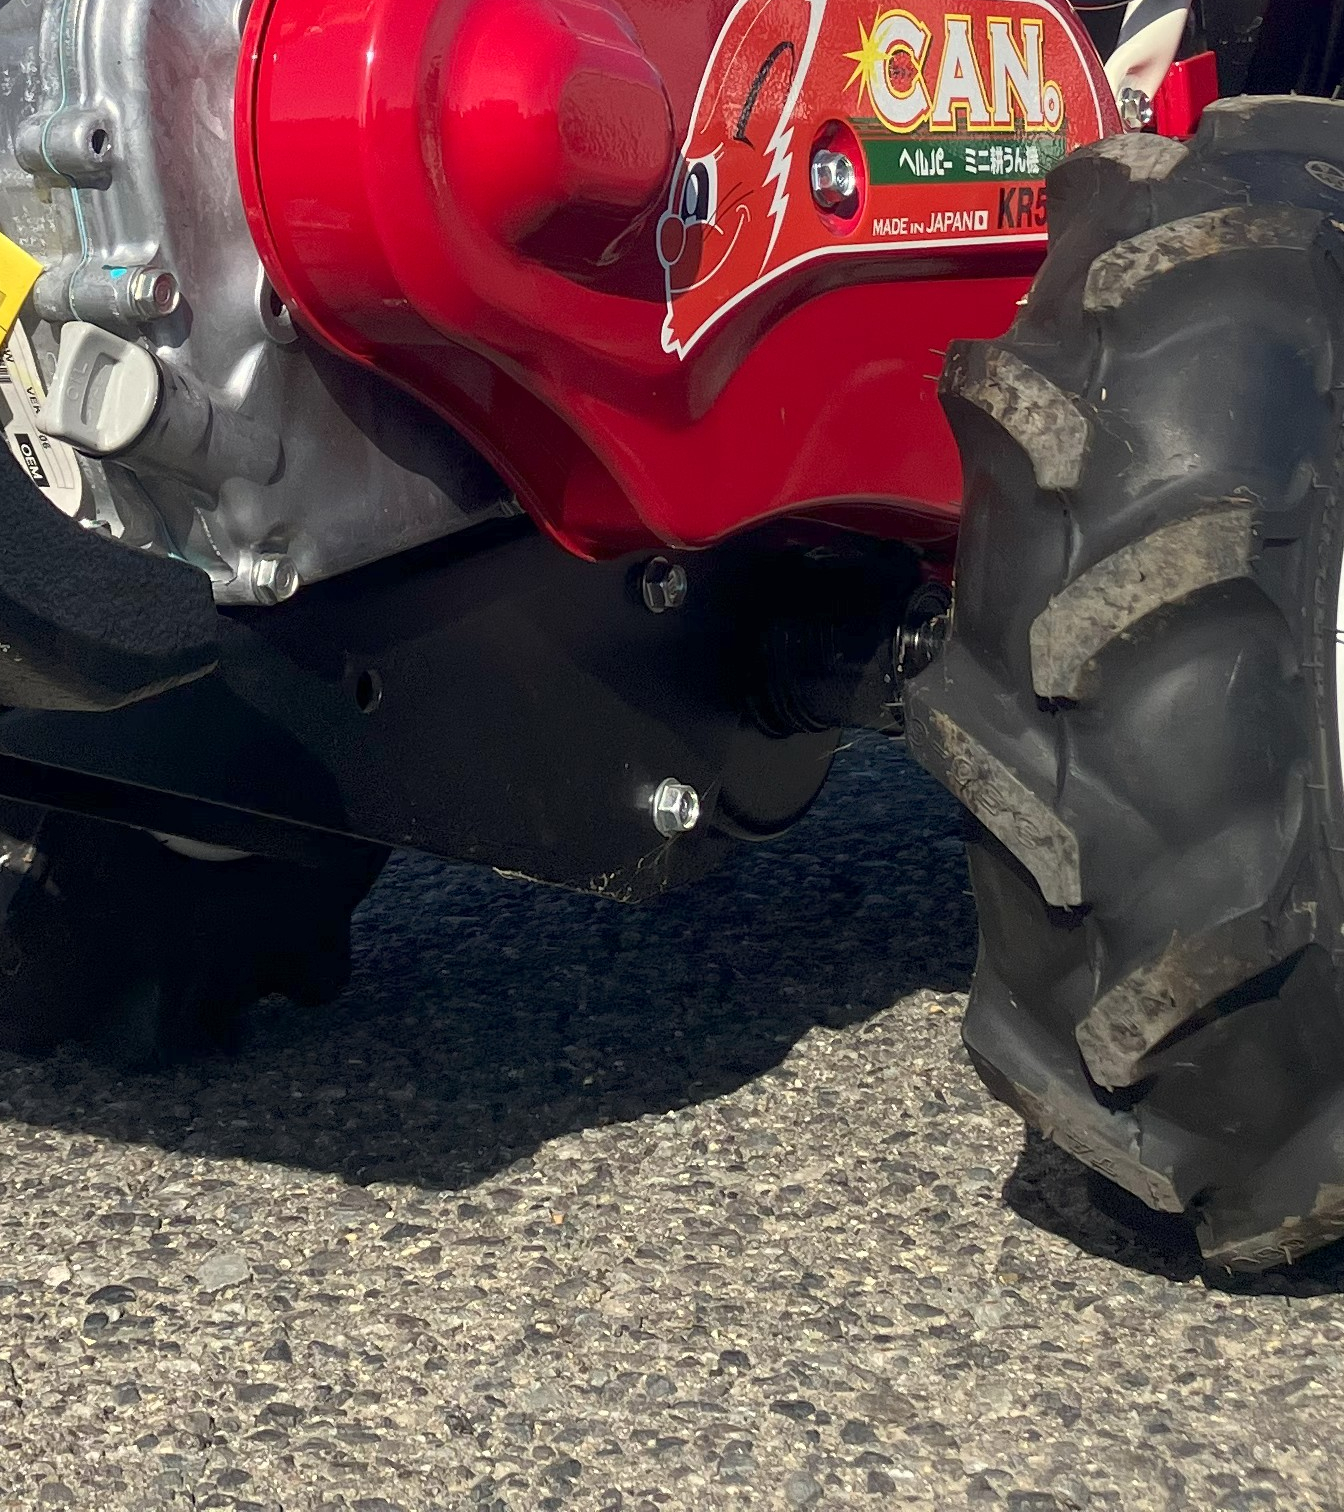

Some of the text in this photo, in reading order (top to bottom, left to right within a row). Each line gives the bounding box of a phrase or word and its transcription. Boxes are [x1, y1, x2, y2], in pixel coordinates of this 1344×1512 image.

[899, 145, 1040, 177] ヘルパー ミニ耕うん機
[872, 218, 908, 236] MADE
[926, 211, 974, 233] JAPAN
[20, 443, 44, 480] OEM
